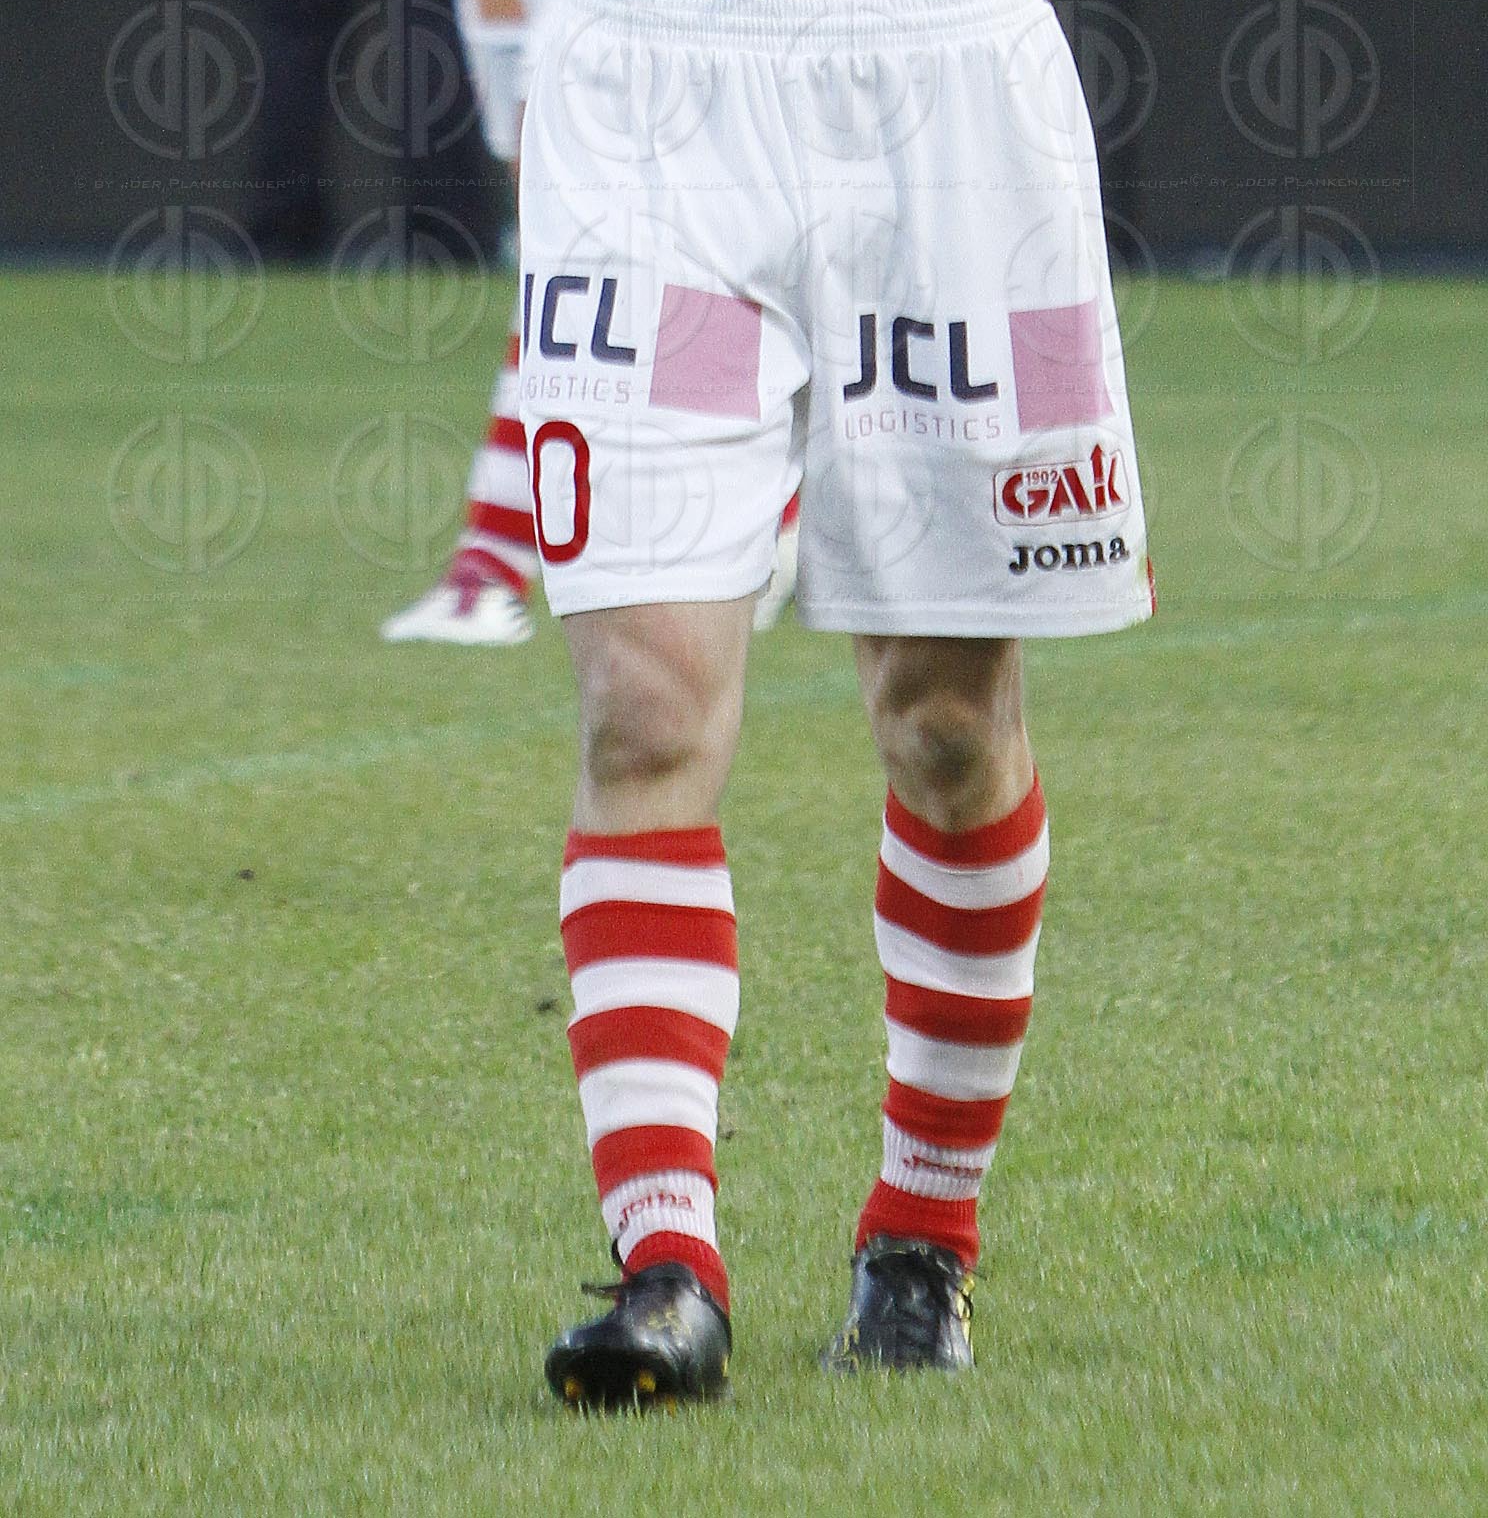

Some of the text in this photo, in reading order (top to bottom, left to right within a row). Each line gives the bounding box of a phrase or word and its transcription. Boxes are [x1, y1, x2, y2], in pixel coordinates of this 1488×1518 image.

[843, 313, 999, 404] JCL
[844, 409, 1002, 442] LOGISTICS
[1001, 443, 1126, 520] GAK
[1024, 470, 1060, 486] 1902
